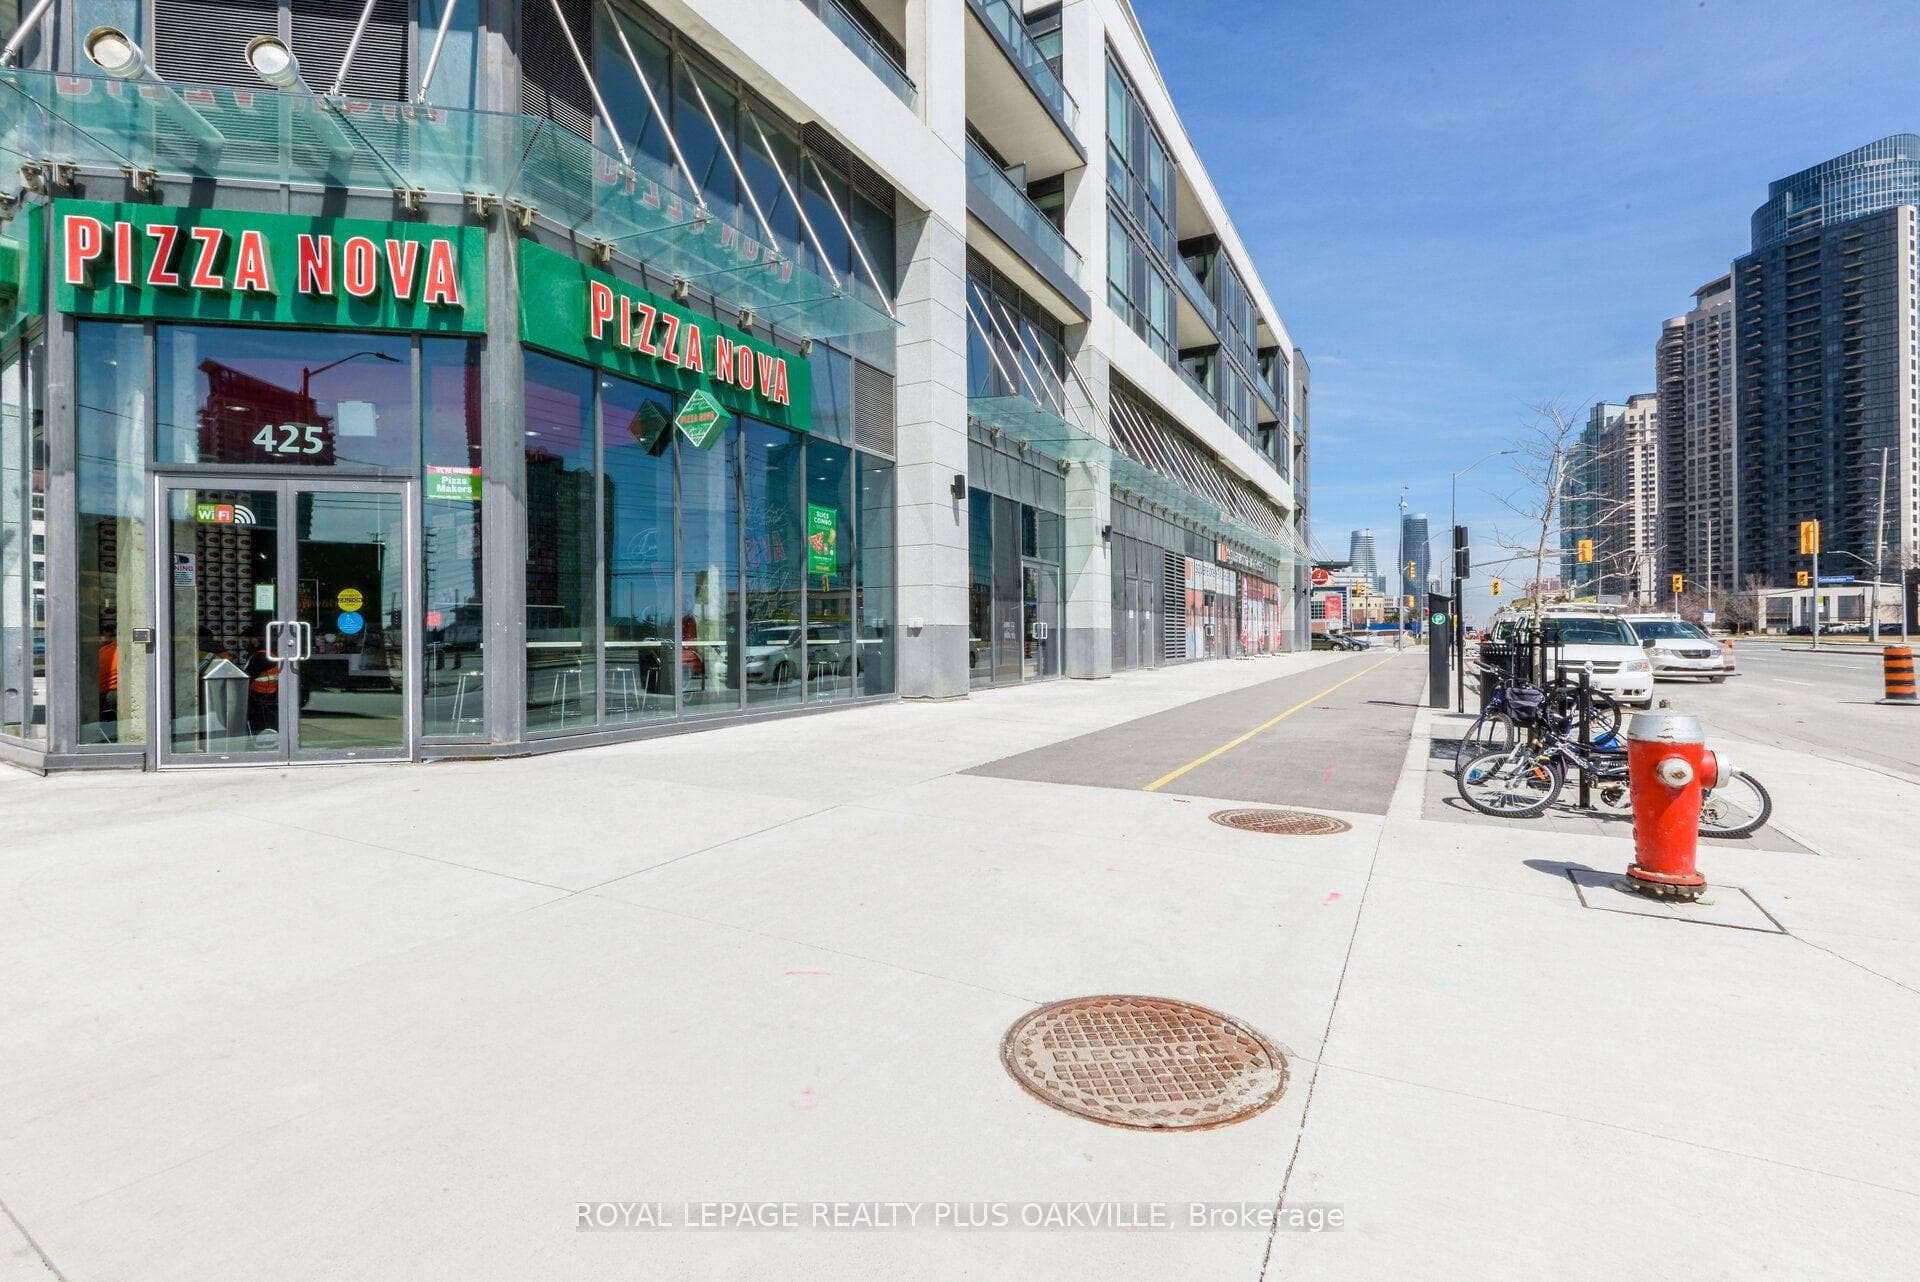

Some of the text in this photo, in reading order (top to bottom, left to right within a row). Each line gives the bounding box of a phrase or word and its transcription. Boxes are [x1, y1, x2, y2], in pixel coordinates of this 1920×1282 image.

[64, 215, 459, 305] PIZZA NOVA
[590, 279, 790, 406] PIZZA NOVA
[252, 424, 324, 454] 425
[436, 484, 473, 493] Makers
[441, 476, 468, 484] Pizza
[813, 516, 832, 526] COMBO
[1052, 1043, 1230, 1063] ELECTRICAL
